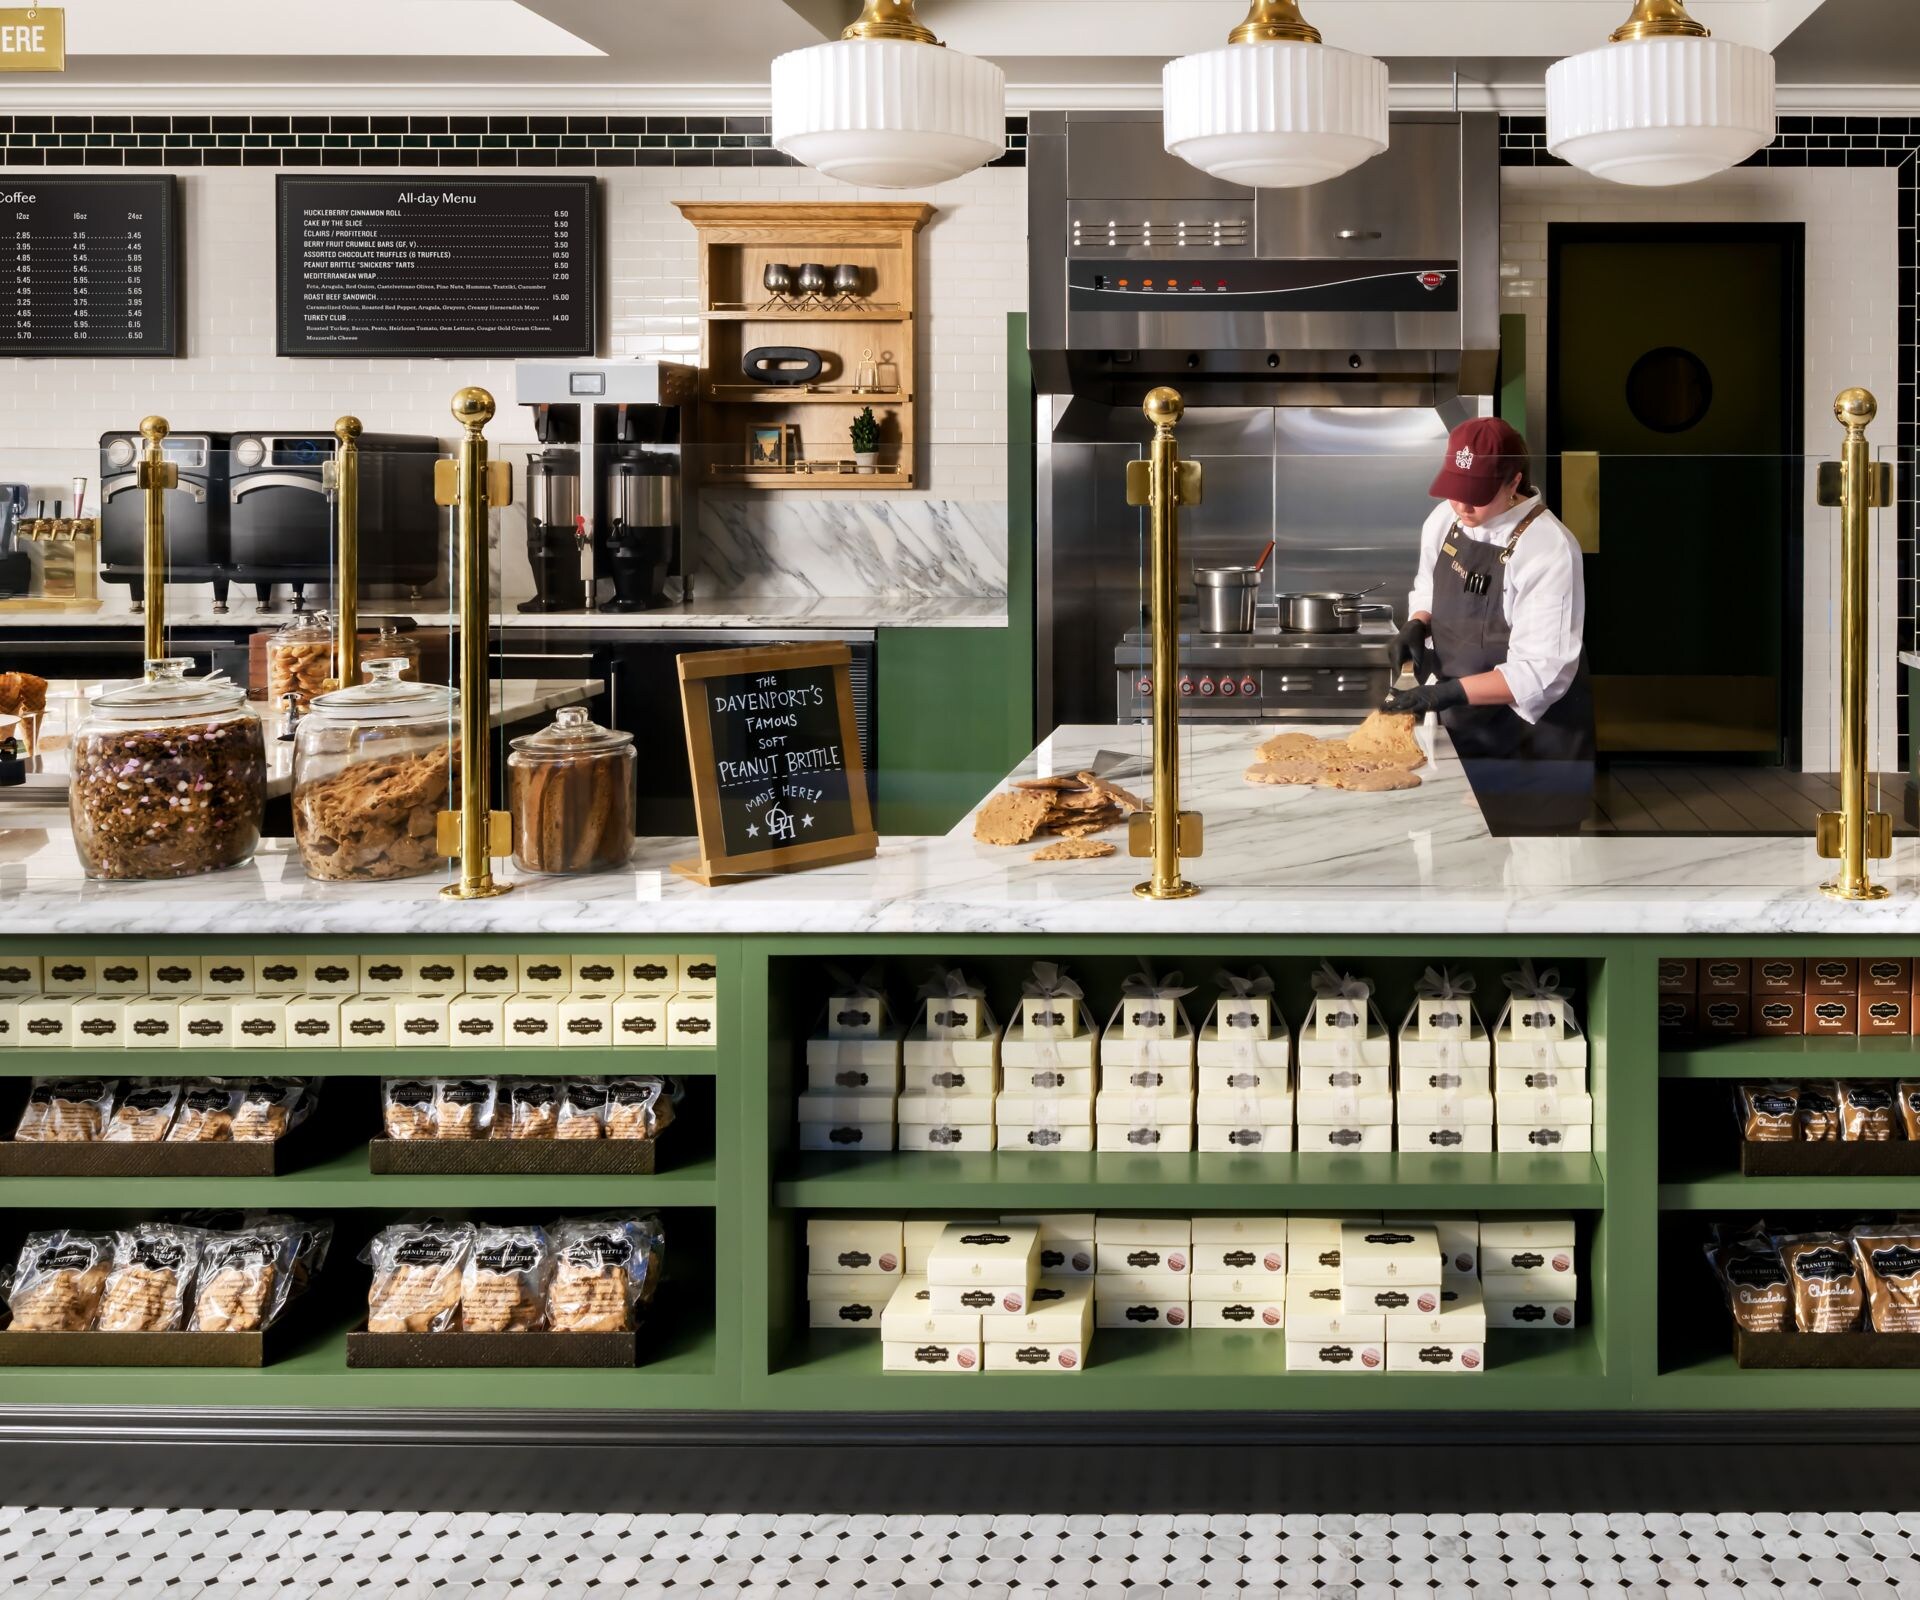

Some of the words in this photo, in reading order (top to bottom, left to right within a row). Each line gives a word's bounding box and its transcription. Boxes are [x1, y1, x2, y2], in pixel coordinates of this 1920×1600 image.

[398, 192, 440, 206] All-day
[442, 192, 477, 204] Menu
[756, 676, 777, 688] THE
[715, 684, 823, 712] DAVENPORT'S
[746, 713, 798, 733] FAMOUS
[758, 736, 788, 749] SOFT
[719, 755, 779, 782] PEANUT
[785, 746, 840, 772] BRITTLE
[746, 788, 776, 812] MADE
[782, 785, 823, 803] HERE!
[1740, 1290, 1786, 1304] Chocolate
[1808, 1284, 1854, 1298] Chocolate
